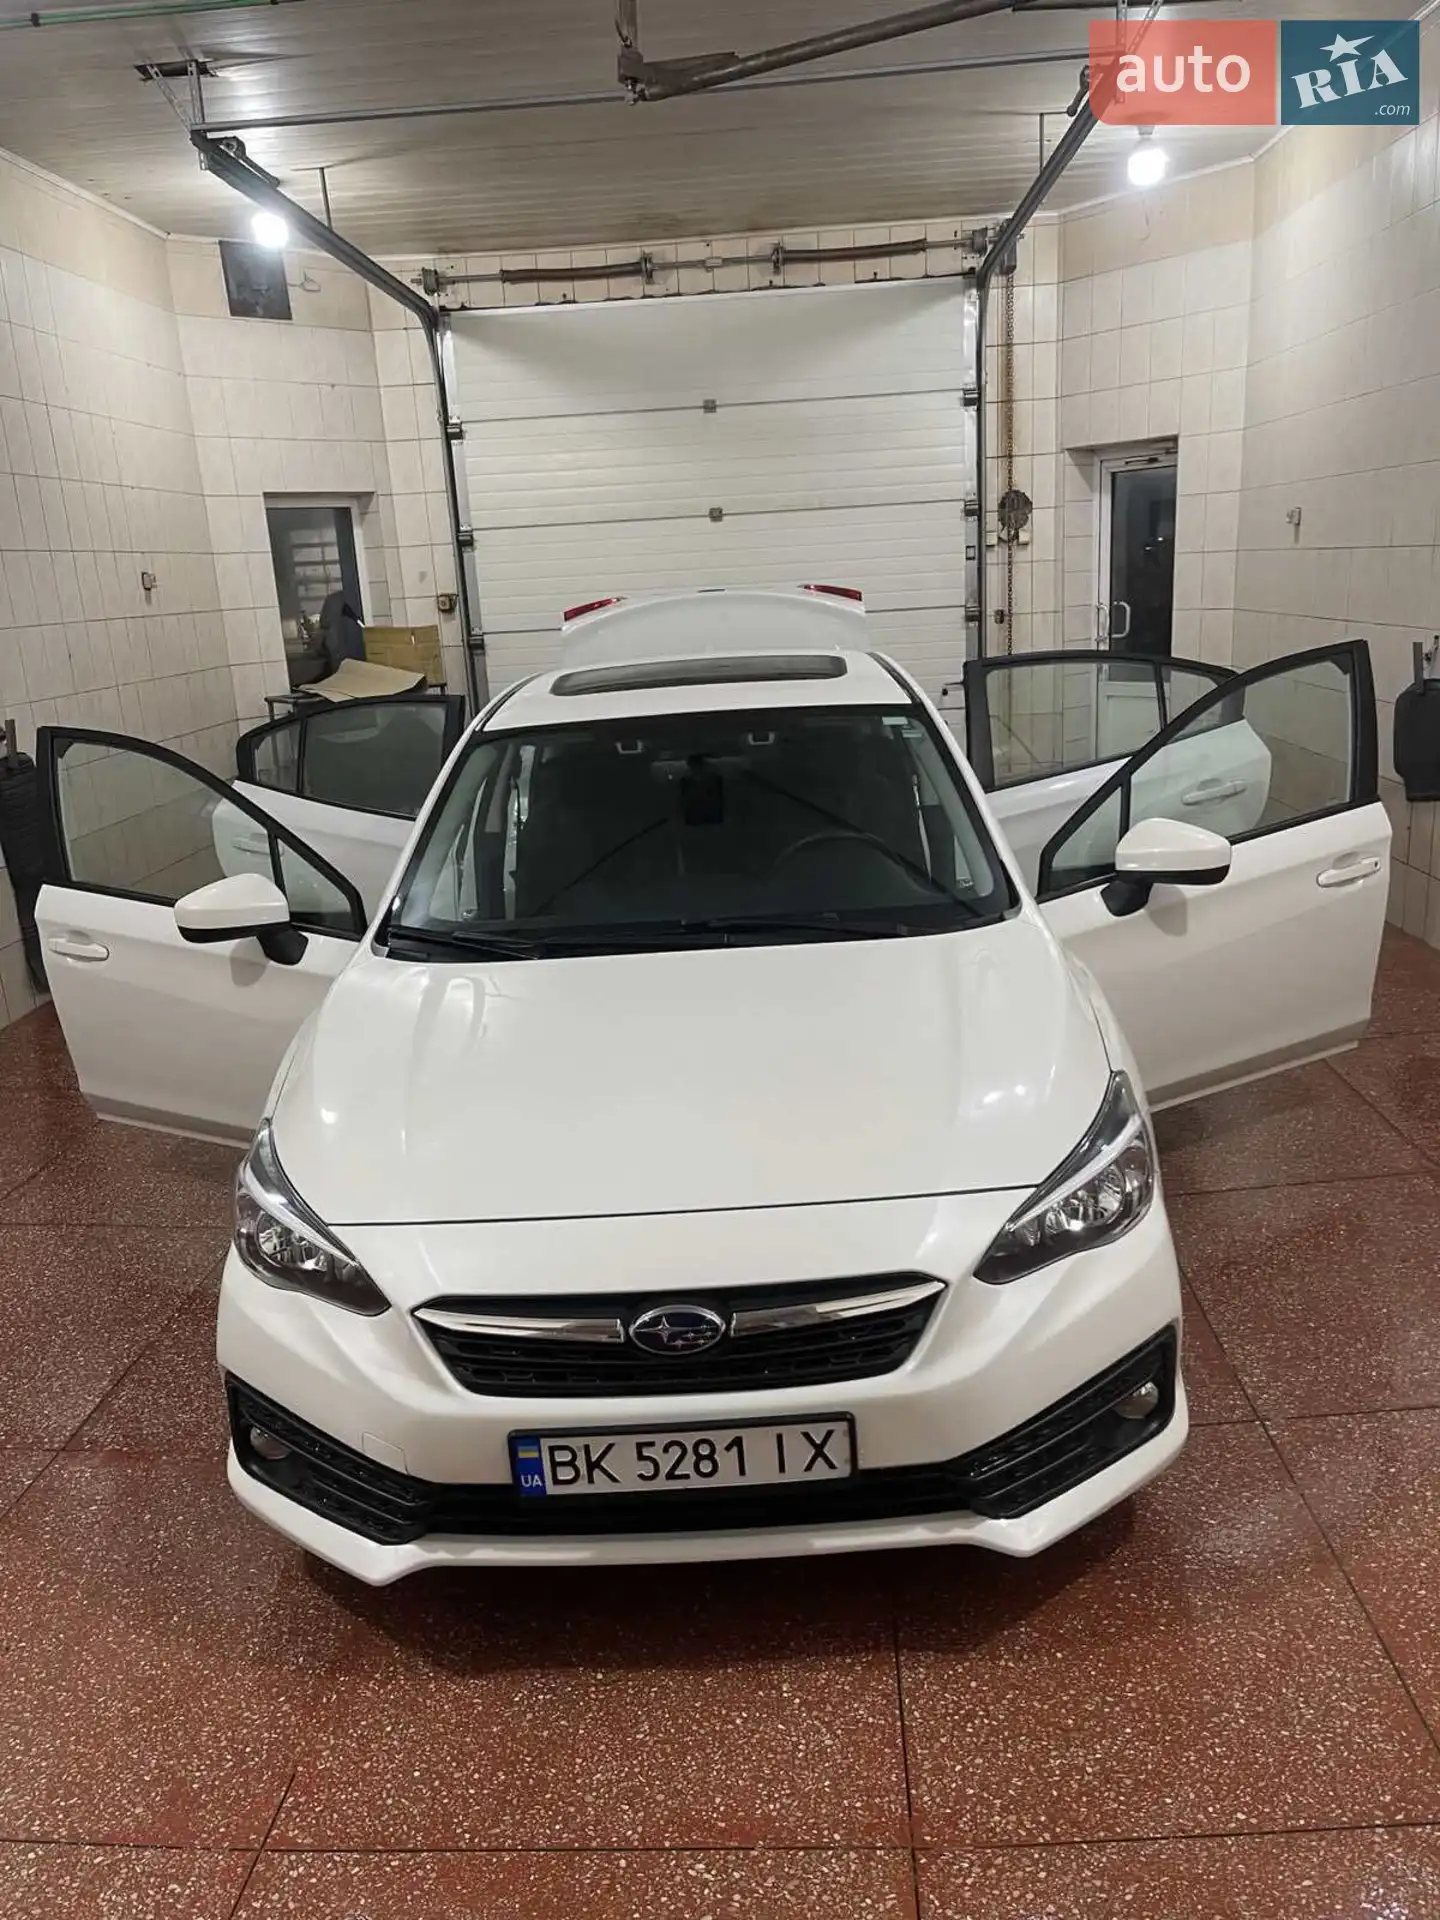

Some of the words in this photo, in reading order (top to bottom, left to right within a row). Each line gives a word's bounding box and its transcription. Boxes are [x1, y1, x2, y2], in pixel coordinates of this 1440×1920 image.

[548, 1442, 621, 1485] BK
[635, 1435, 746, 1482] 5281
[521, 1474, 543, 1488] UA
